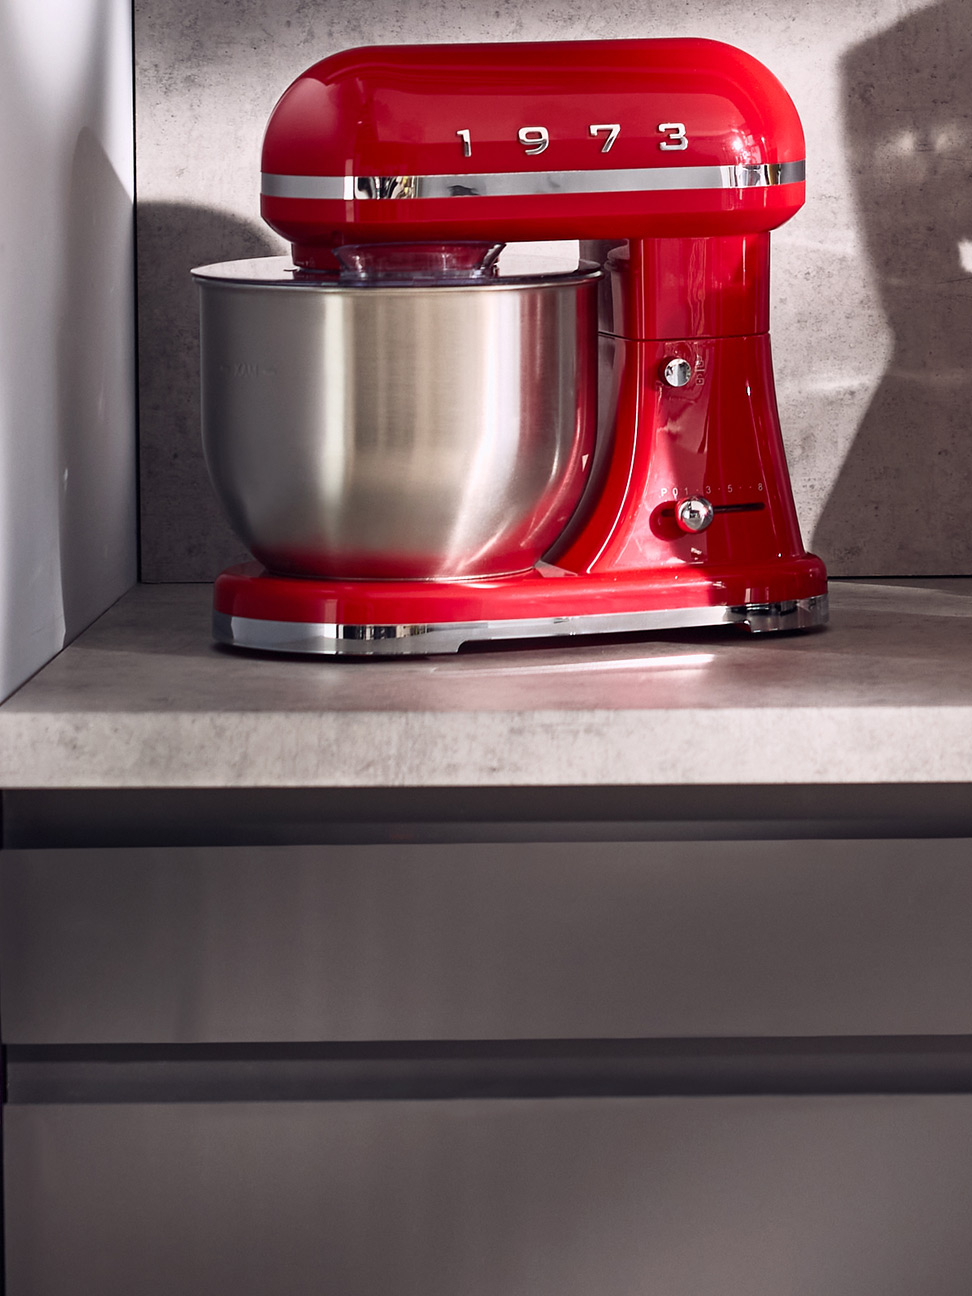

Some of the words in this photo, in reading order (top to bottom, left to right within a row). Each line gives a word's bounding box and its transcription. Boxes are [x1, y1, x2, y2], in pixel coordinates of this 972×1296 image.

[456, 121, 689, 158] 1973
[661, 487, 667, 497] P
[706, 485, 711, 494] 3
[728, 484, 733, 493] 5
